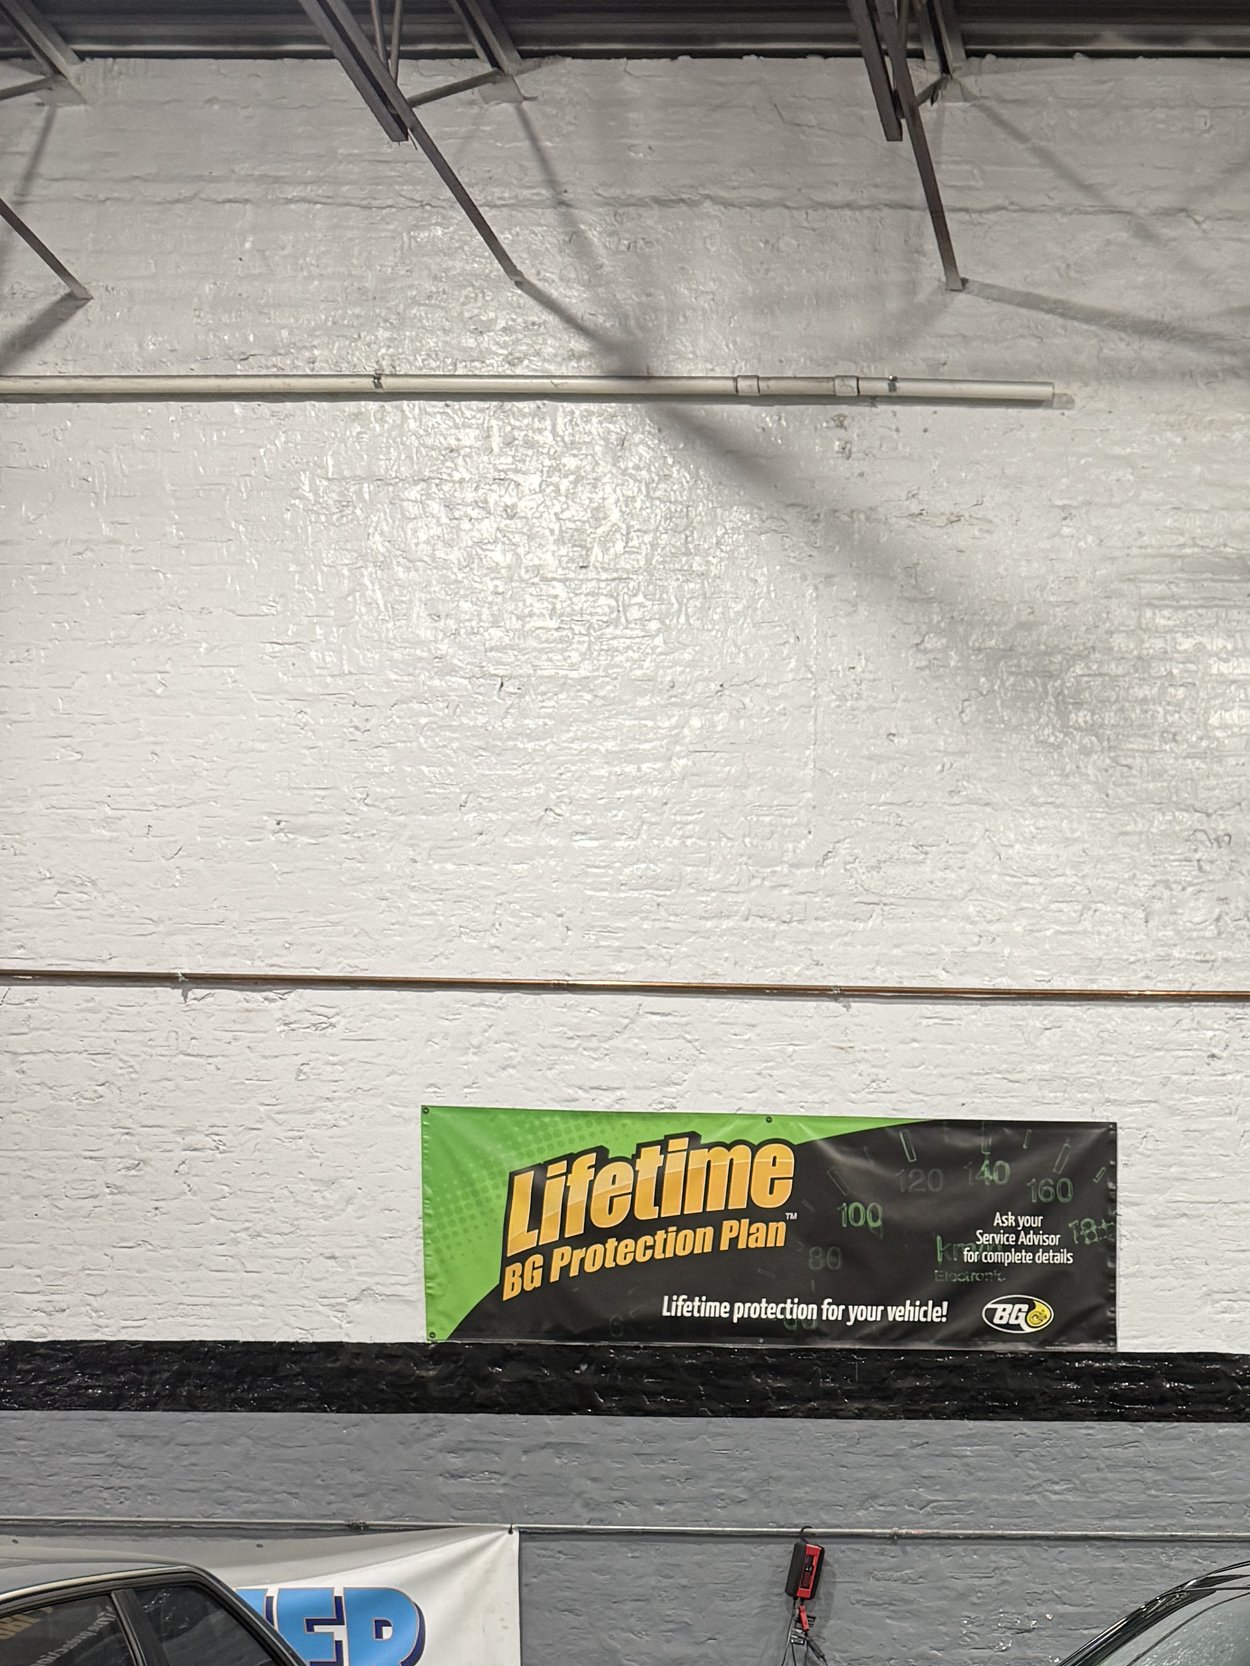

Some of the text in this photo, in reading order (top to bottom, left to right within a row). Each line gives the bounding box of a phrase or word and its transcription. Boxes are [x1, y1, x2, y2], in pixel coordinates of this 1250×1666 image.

[895, 1167, 944, 1192] 120
[1027, 1178, 1074, 1203] 160
[507, 1136, 795, 1257] Lifetime
[838, 1203, 884, 1228] 100
[994, 1212, 1044, 1231] Ask your
[975, 1230, 1061, 1247] Service Advisor
[502, 1253, 544, 1301] BG
[549, 1226, 714, 1284] Protection
[720, 1218, 787, 1252] Plan
[808, 1246, 842, 1271] 80
[963, 1248, 1074, 1267] for complete details
[662, 1295, 730, 1319] Lifetime
[733, 1297, 819, 1325] protection
[821, 1298, 844, 1321] for
[845, 1302, 885, 1327] your
[887, 1299, 948, 1323] vehicle!
